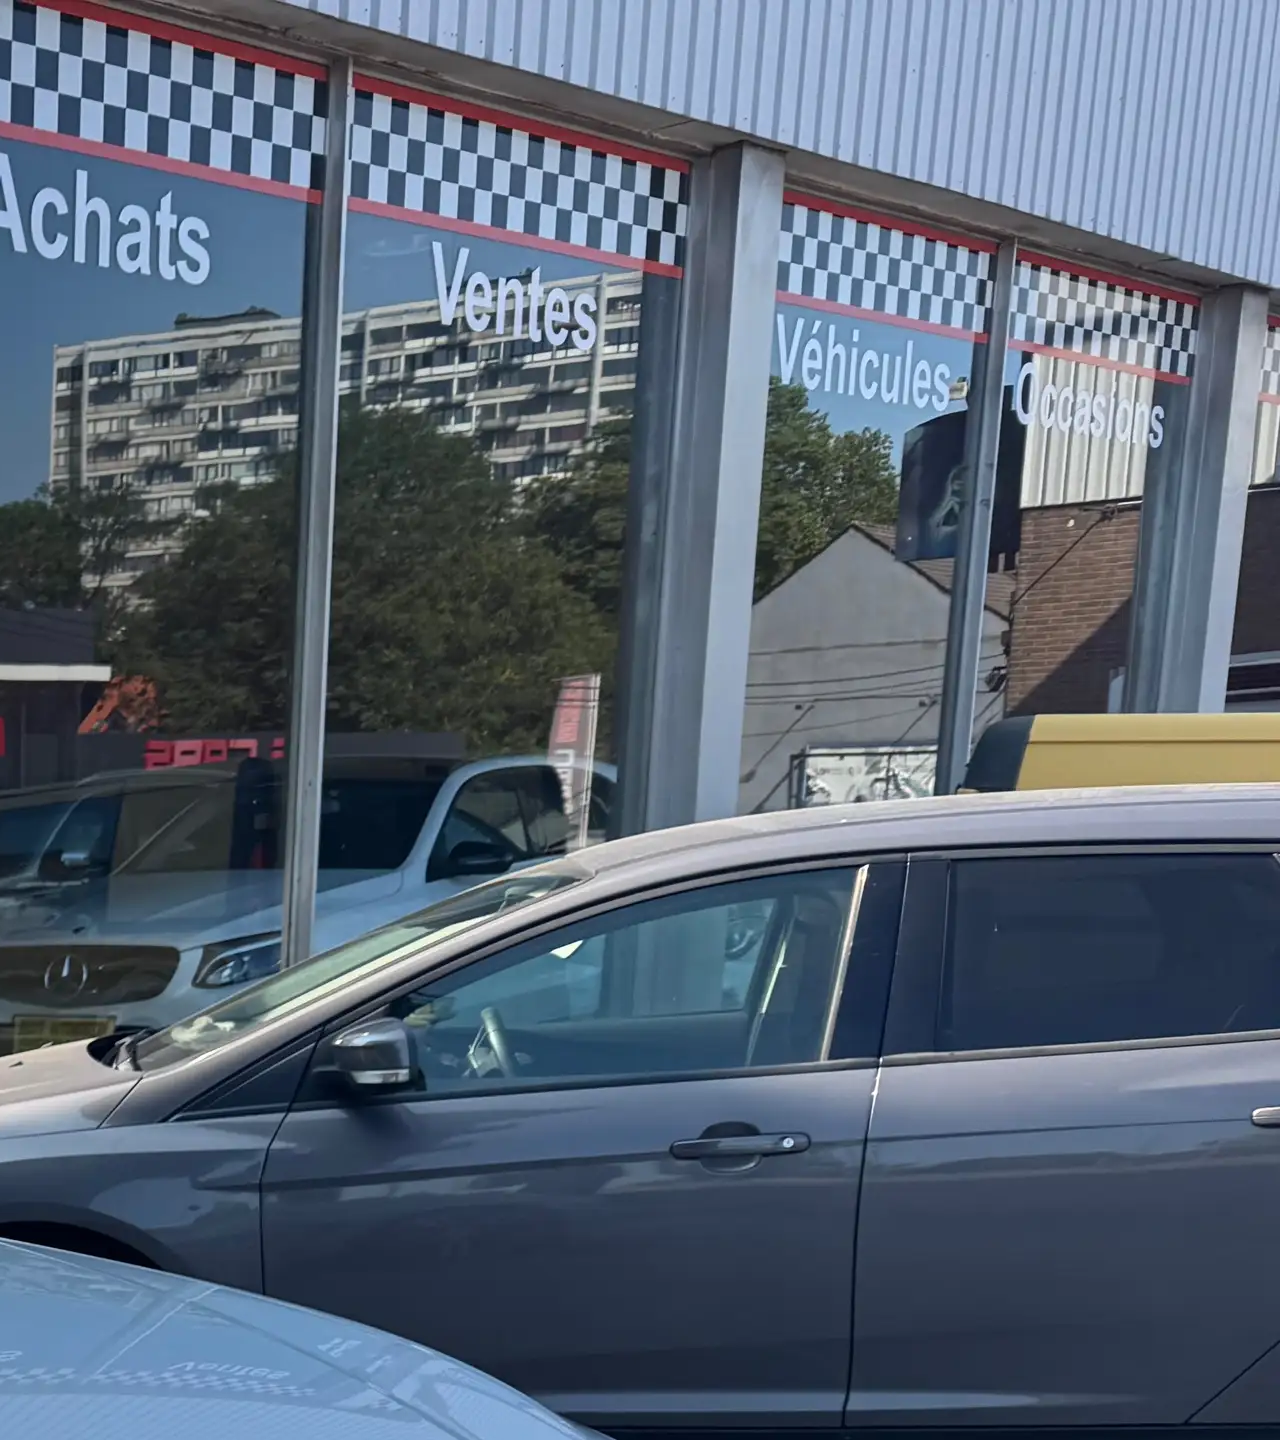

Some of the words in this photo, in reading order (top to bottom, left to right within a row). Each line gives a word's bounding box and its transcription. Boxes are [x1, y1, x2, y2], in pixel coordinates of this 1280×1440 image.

[432, 241, 597, 350] Ventes
[777, 313, 951, 411] Véhicules
[1015, 362, 1165, 448] Occasions
